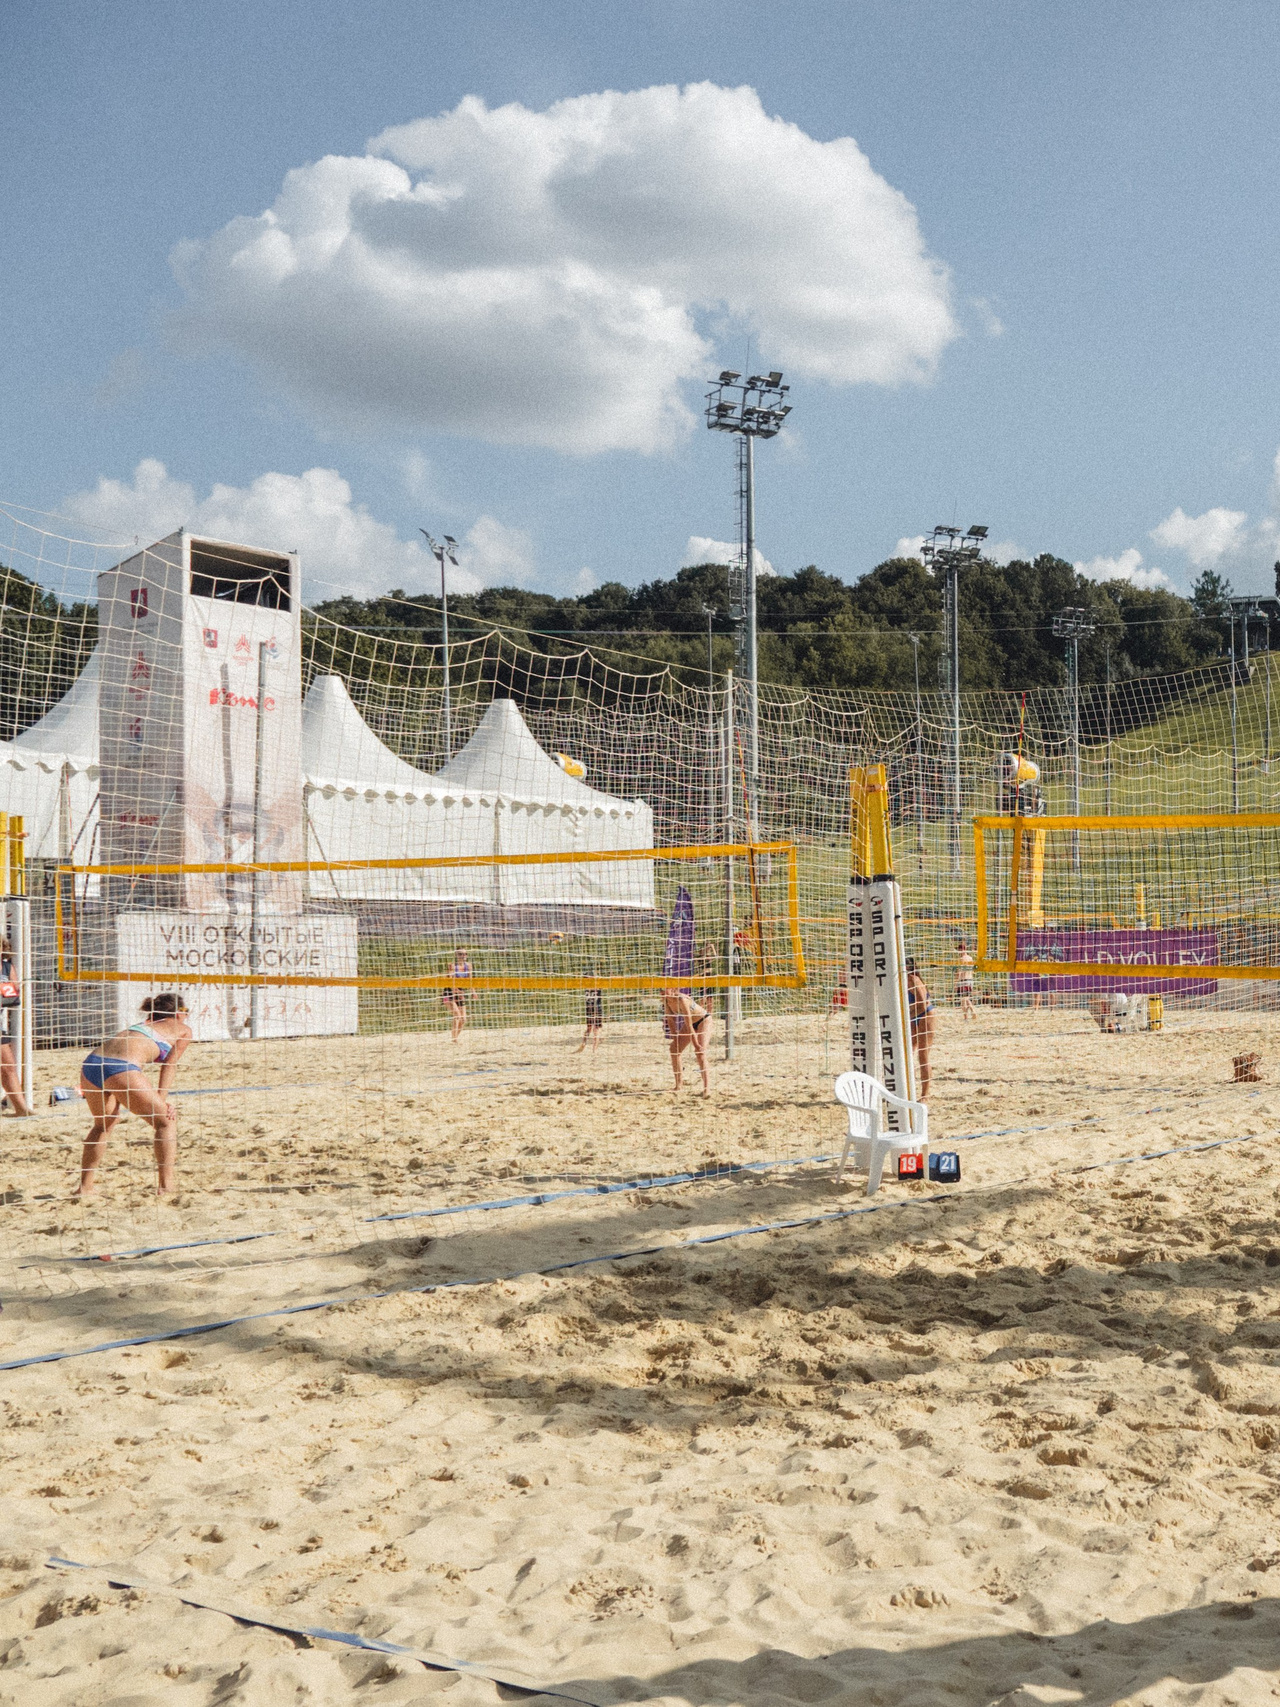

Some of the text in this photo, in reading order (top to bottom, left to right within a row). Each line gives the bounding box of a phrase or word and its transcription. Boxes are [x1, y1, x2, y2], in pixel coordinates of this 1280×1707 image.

[160, 925, 195, 943] VIII
[849, 912, 864, 988] SPORT
[871, 910, 900, 1132] SPORT TRANSE
[902, 1157, 917, 1171] 19
[941, 1155, 956, 1170] 21
